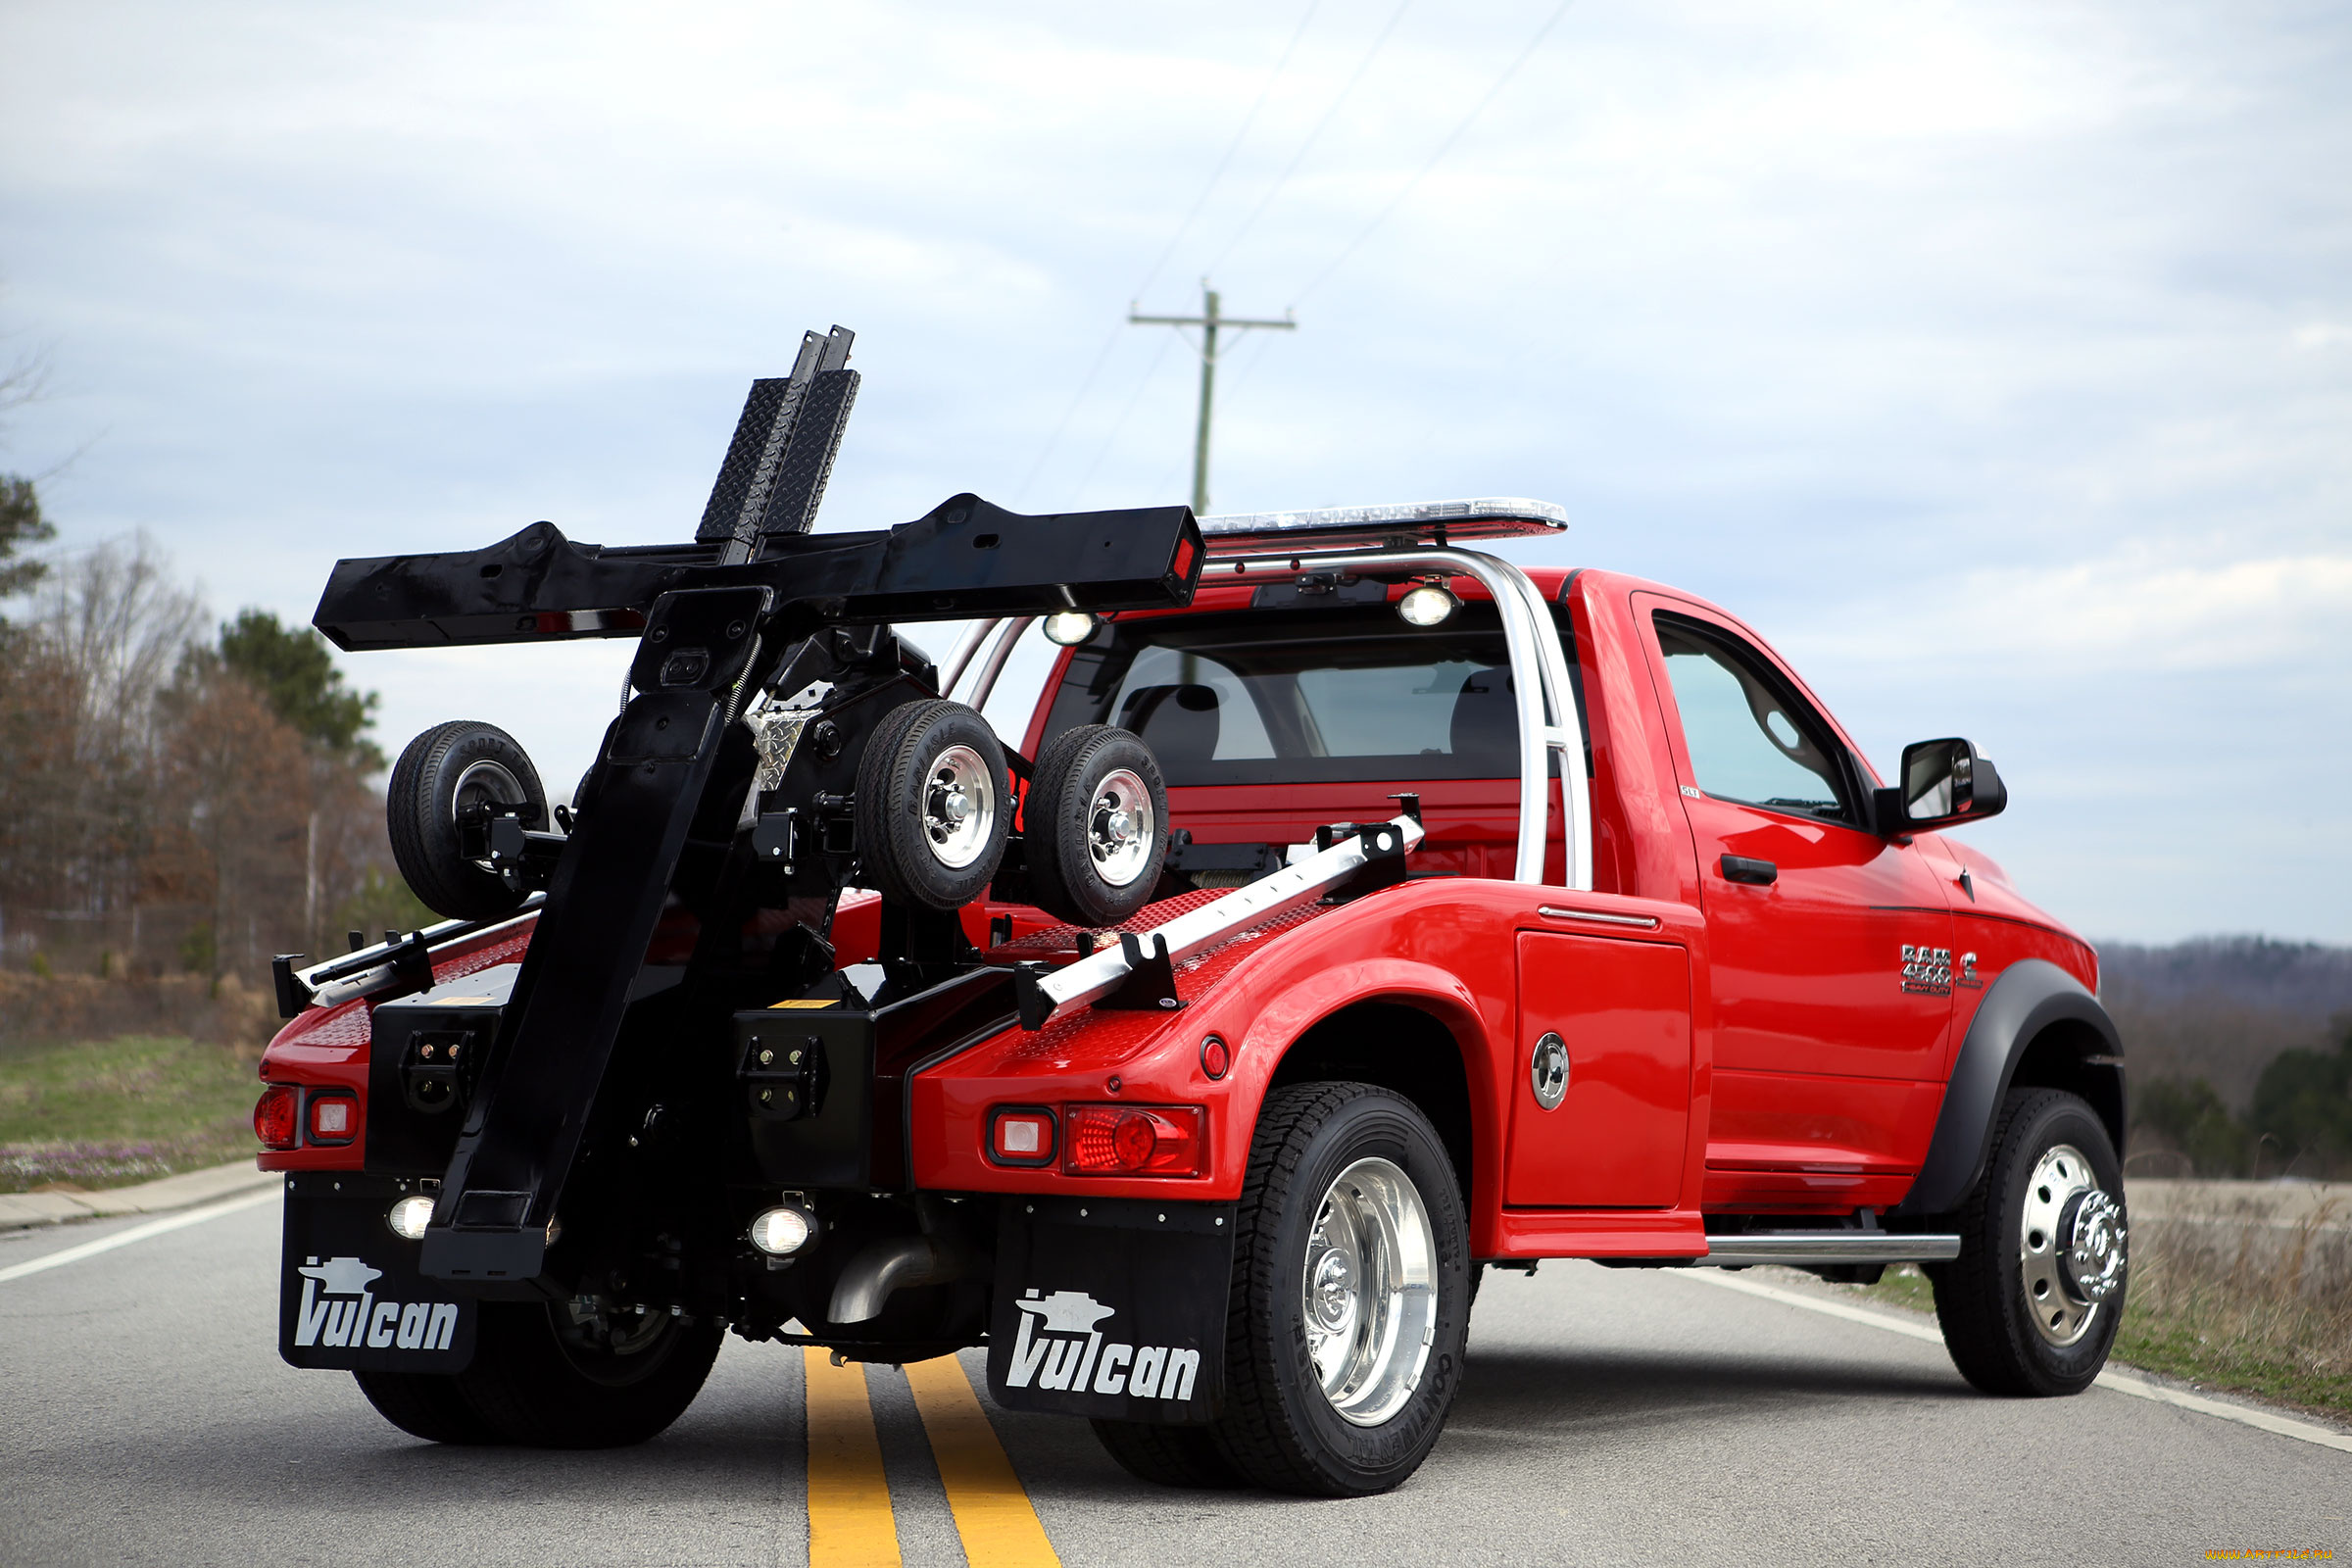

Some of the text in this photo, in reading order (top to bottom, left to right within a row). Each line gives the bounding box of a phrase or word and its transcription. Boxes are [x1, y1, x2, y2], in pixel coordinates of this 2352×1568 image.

[459, 736, 507, 756] SPORT
[1141, 755, 1168, 815] SPORT
[1681, 786, 1698, 797] SLT
[995, 776, 1012, 850] SPORT
[1901, 945, 1951, 966] RAM
[1901, 963, 1951, 985] 4500
[1931, 985, 1949, 995] DUTY
[295, 1277, 459, 1350] Vulcan
[1006, 1311, 1200, 1400] Vulcan
[1348, 1352, 1452, 1465] CONTINENTAL
